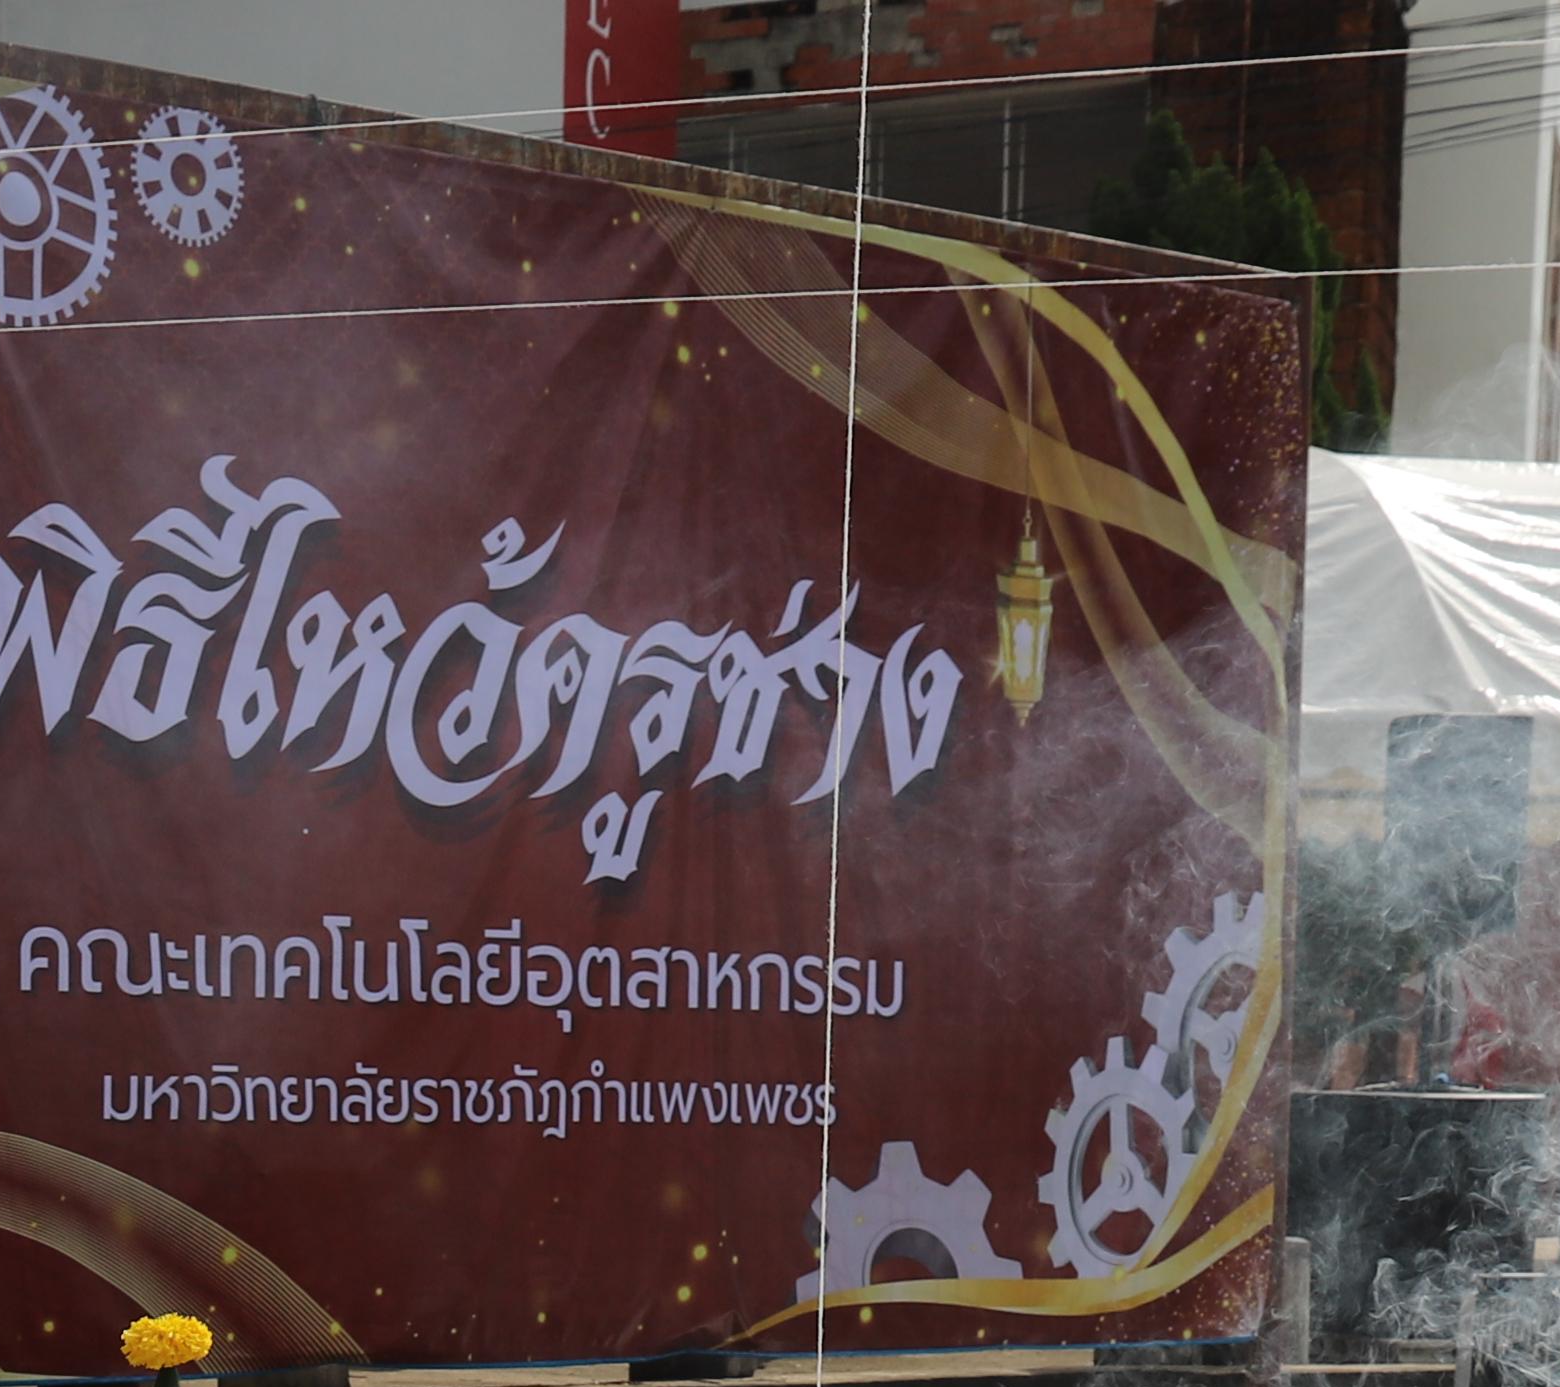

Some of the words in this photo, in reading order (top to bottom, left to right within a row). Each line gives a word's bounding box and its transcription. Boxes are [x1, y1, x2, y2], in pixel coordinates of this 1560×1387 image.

[18, 915, 905, 1032] คณะเทคโนโลยีอุตสาหกรรม
